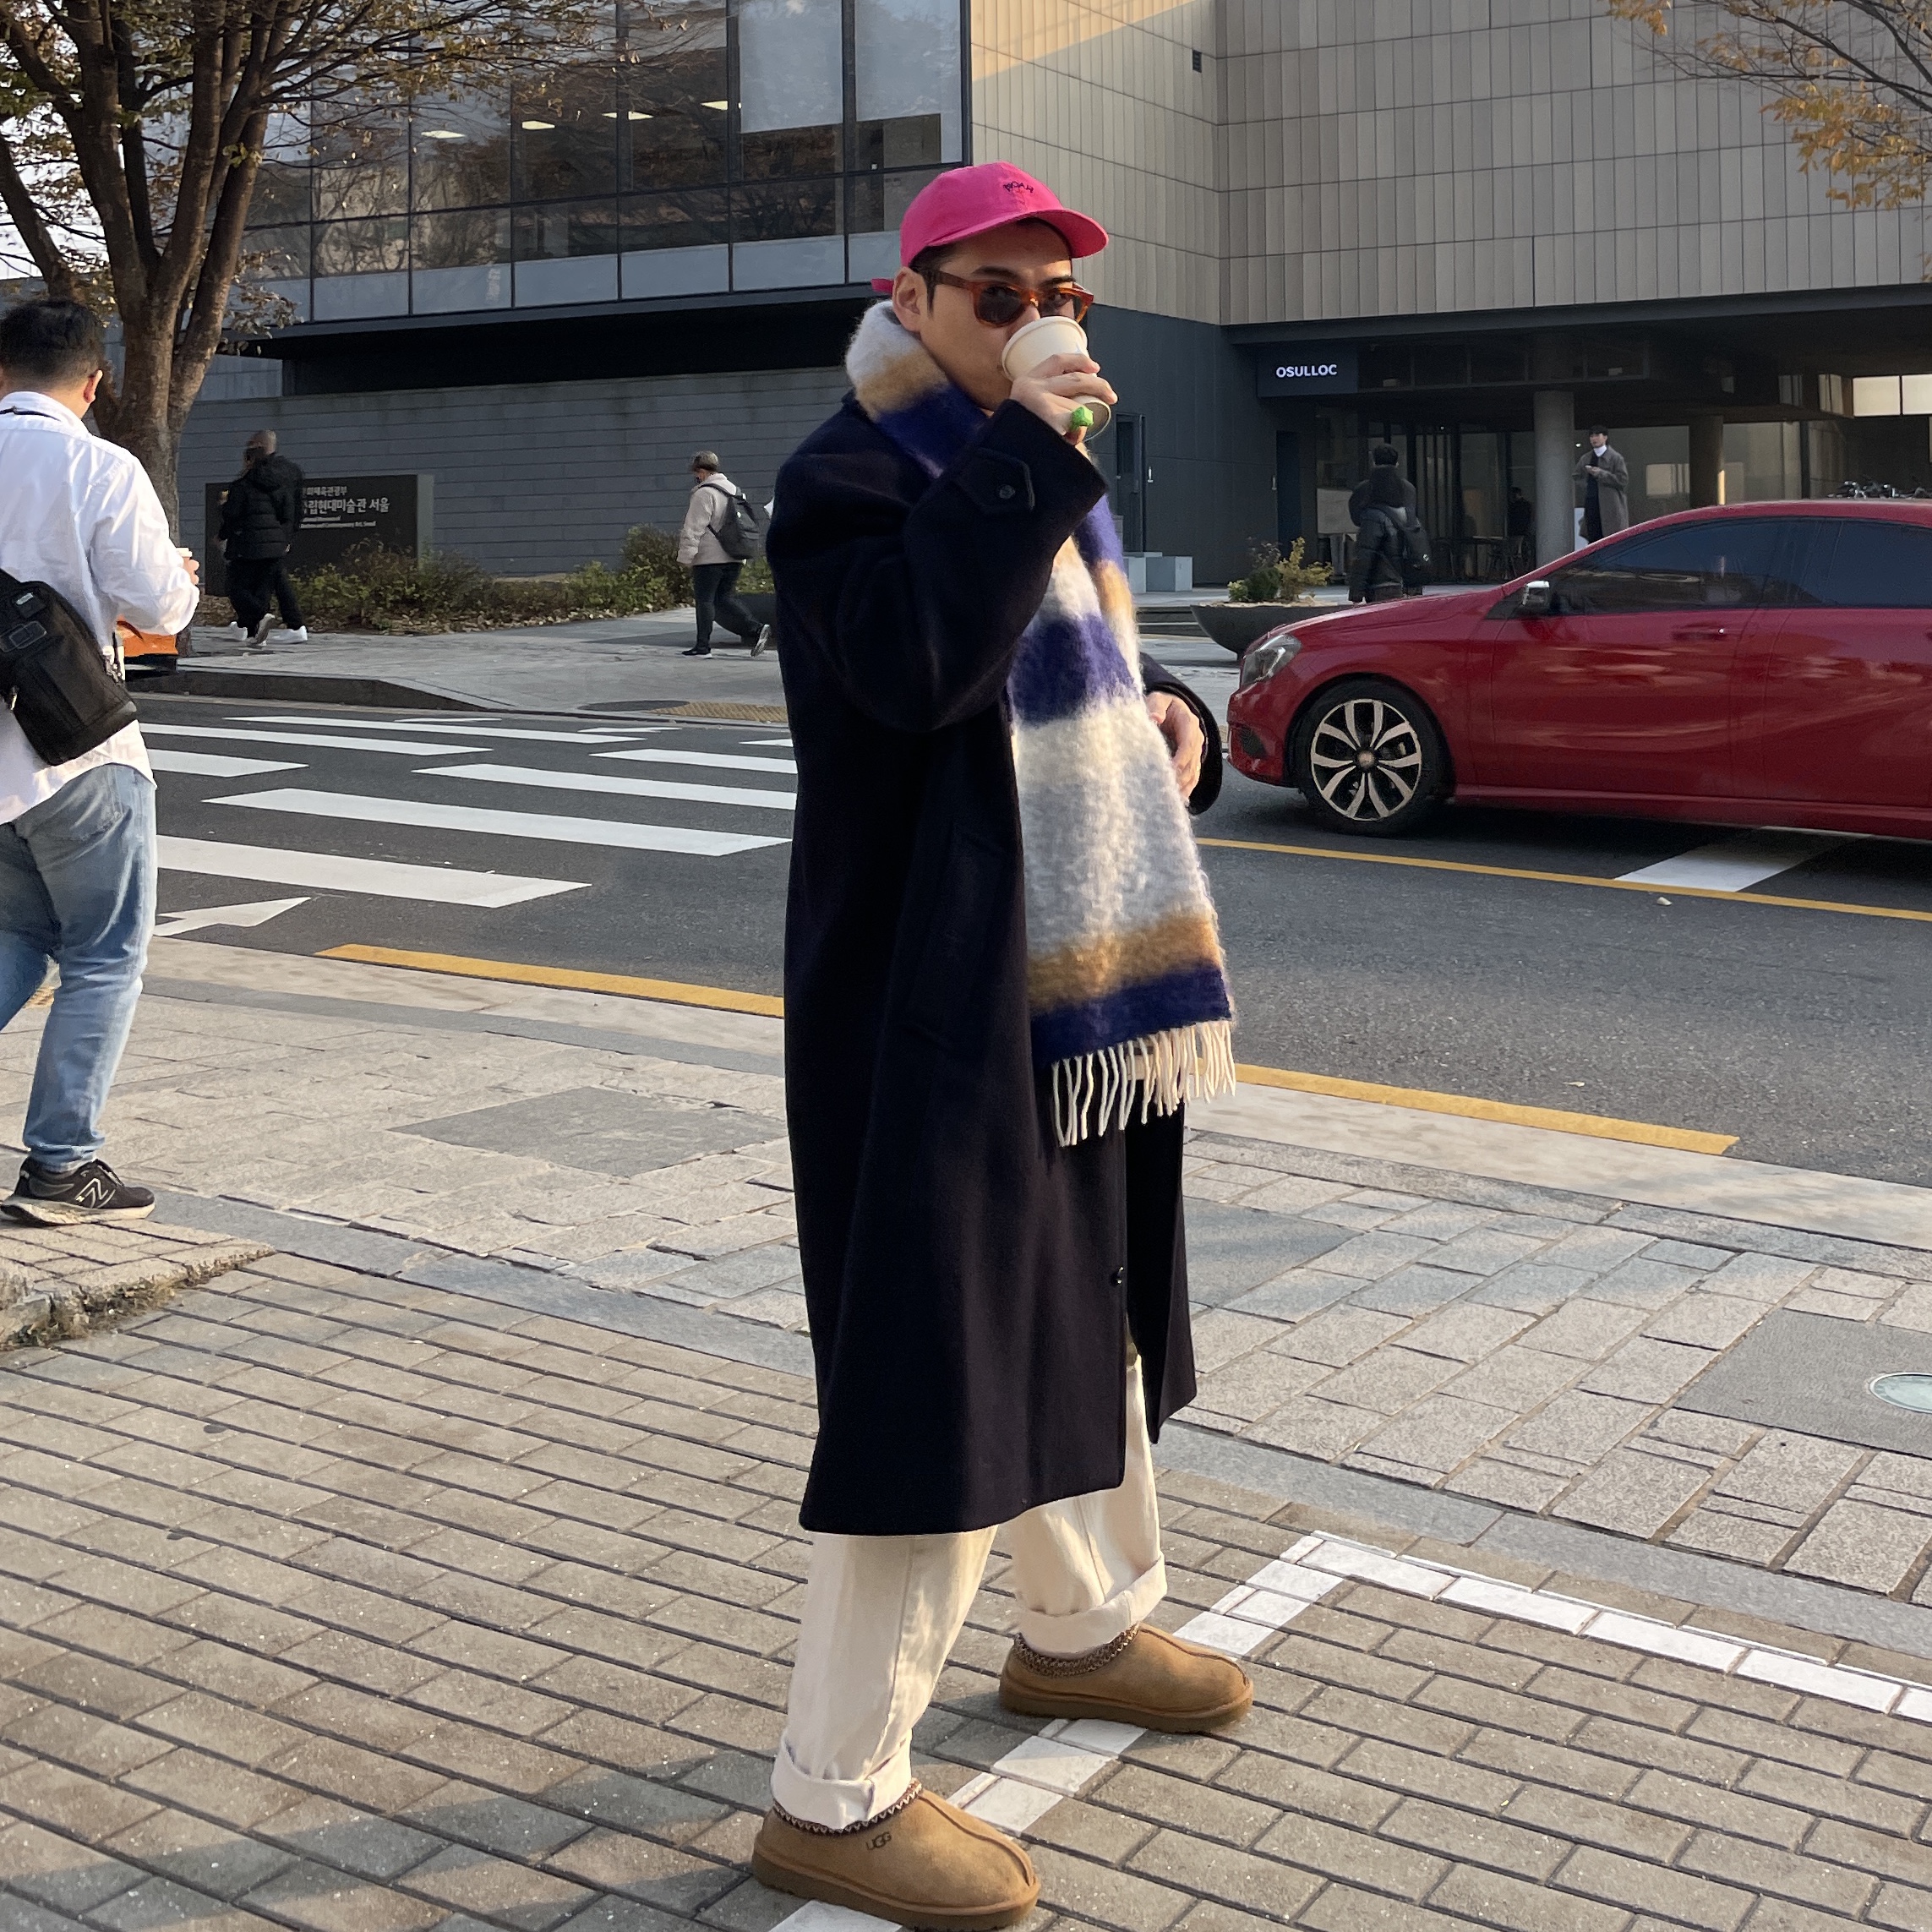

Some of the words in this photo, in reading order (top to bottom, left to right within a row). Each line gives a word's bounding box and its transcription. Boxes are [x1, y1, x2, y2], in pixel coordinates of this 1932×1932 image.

[1275, 364, 1338, 378] OSULLOC
[368, 497, 390, 513] 서울
[865, 1831, 892, 1851] UGG
